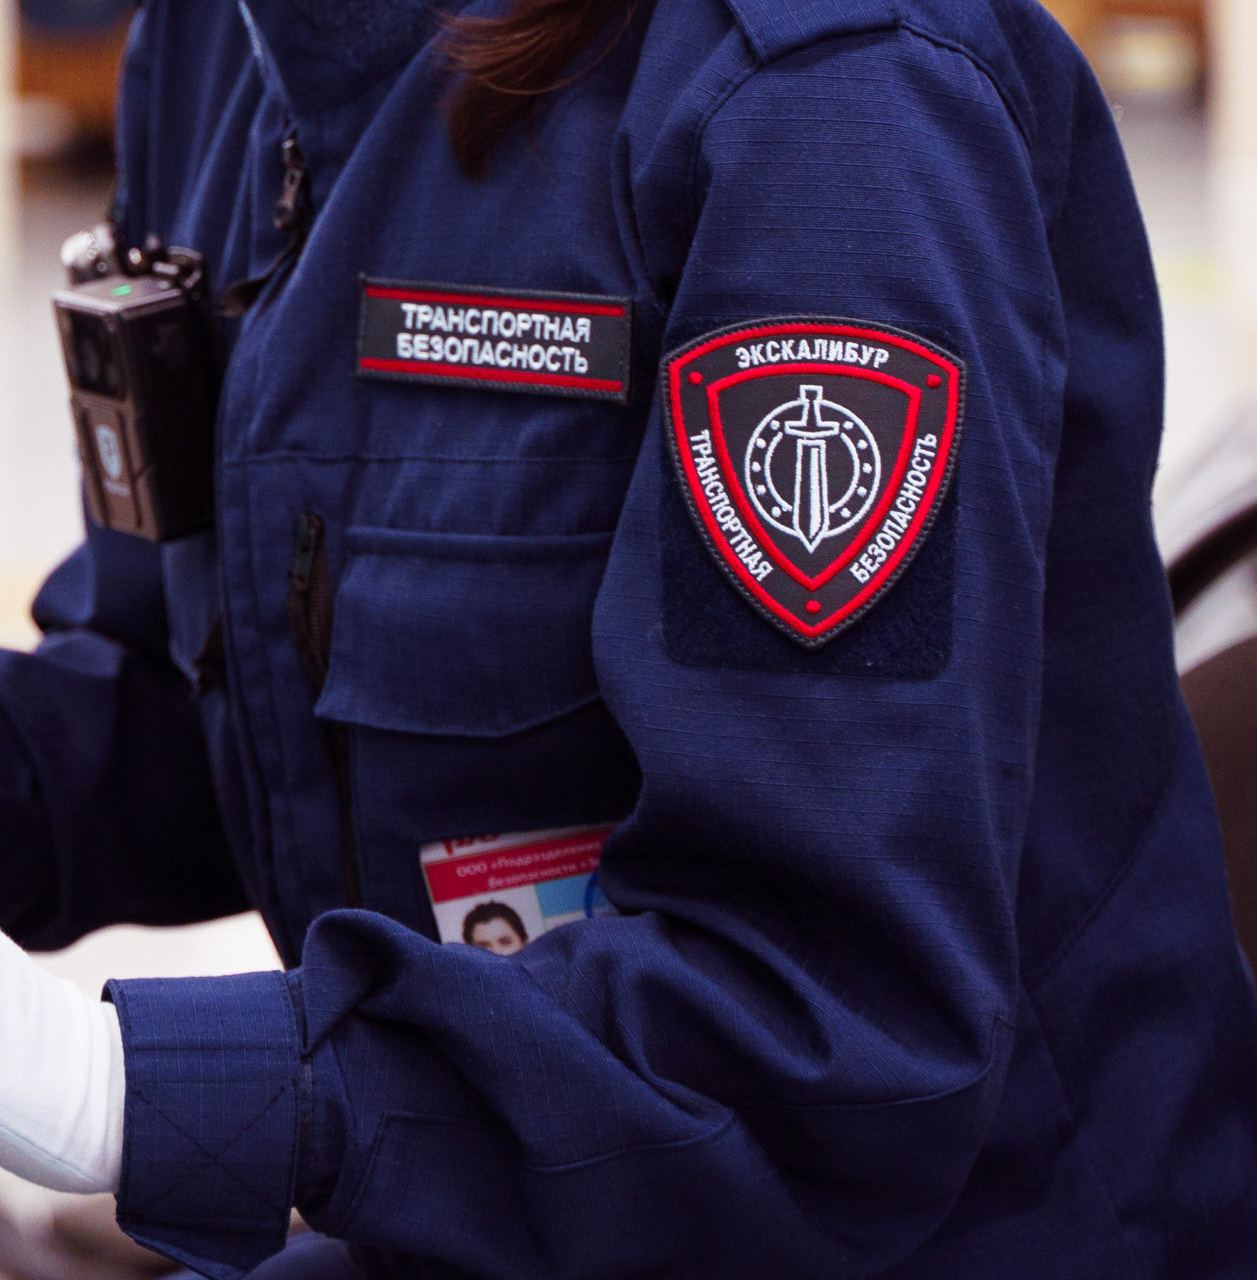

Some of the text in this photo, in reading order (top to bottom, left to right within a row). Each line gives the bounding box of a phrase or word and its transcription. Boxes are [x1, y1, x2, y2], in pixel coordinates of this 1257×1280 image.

[401, 303, 590, 342] ТРАНСПОРТНАЯ
[397, 333, 587, 373] БЕЗОПАСНОСТЬ
[736, 339, 889, 368] ЭКСКАЛИБУР
[690, 429, 773, 581] ТРАНСПОРТНАЯ
[849, 434, 937, 583] БЕЗОПАСНОСТЬ
[456, 861, 488, 878] ООО
